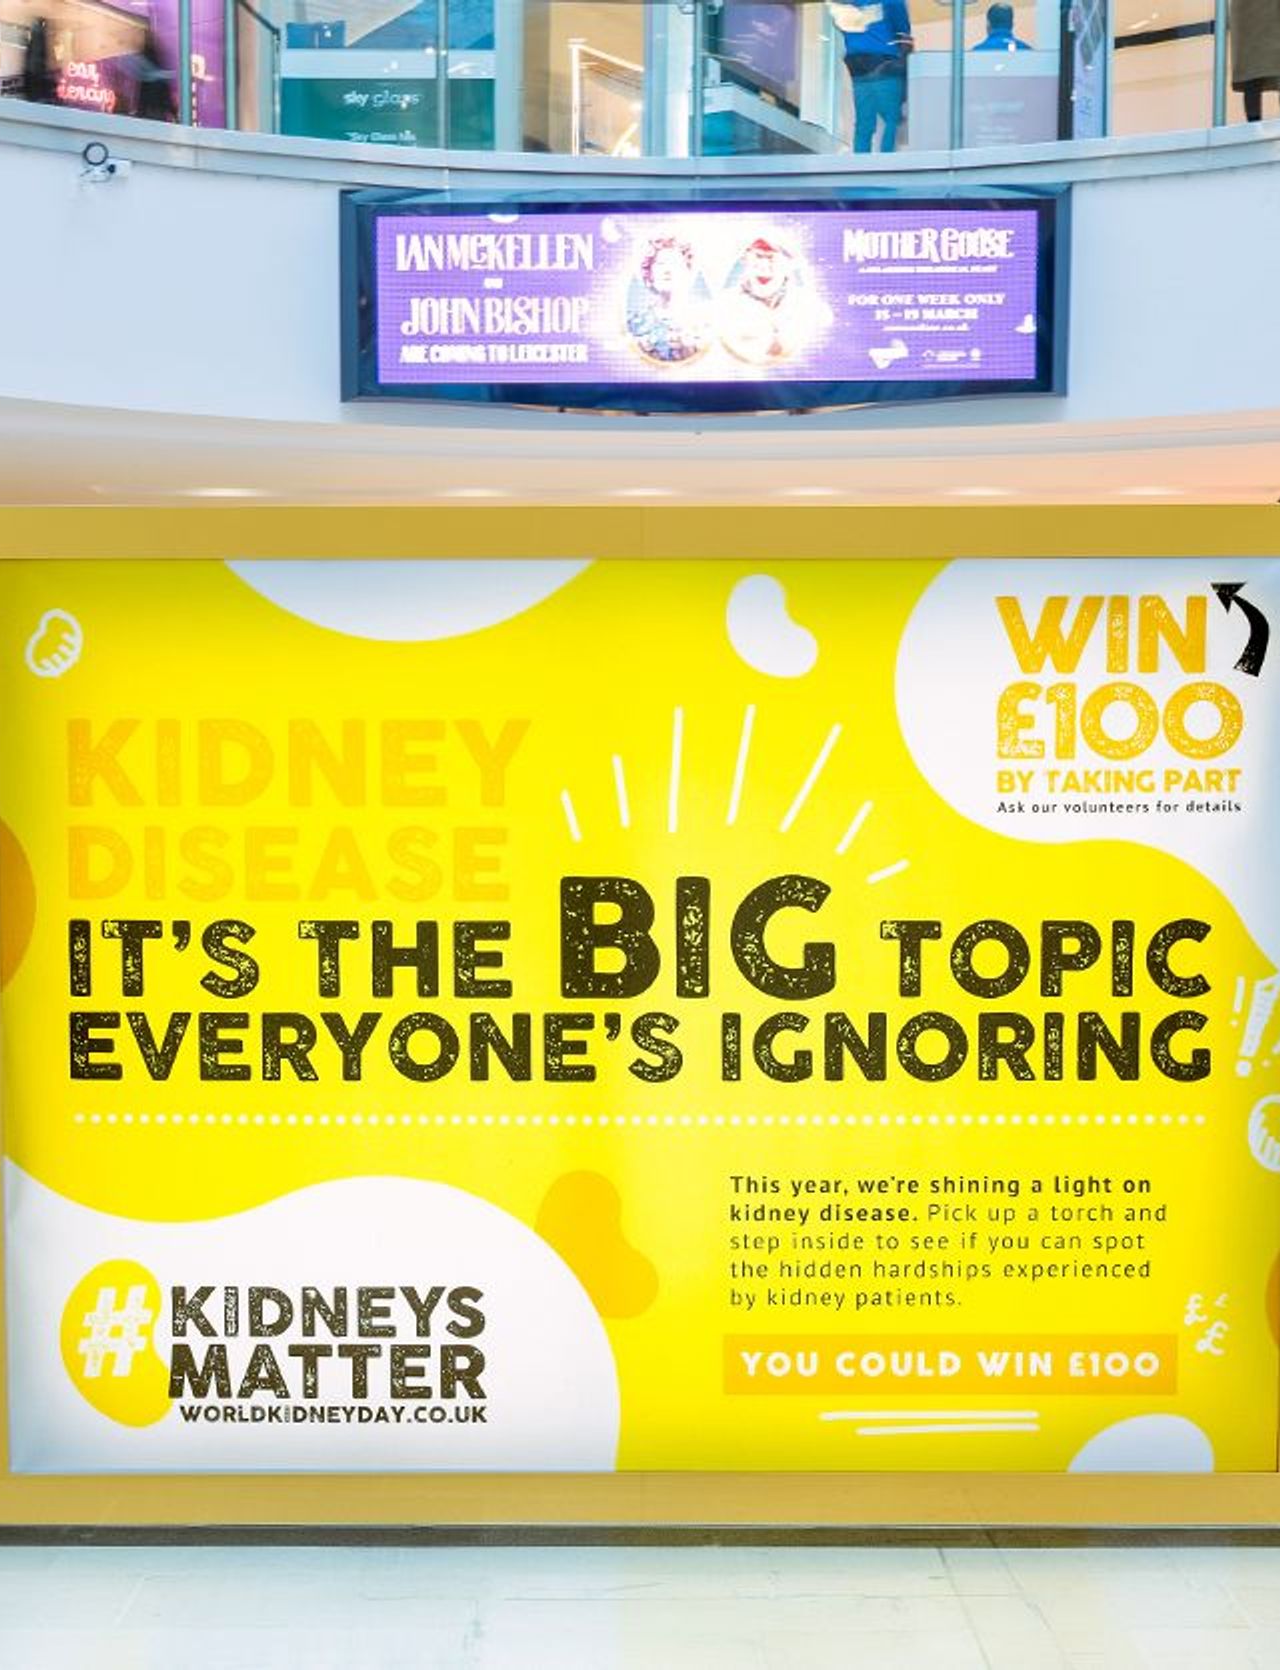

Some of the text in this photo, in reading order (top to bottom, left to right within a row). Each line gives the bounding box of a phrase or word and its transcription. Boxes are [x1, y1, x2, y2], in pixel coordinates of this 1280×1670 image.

[343, 90, 420, 109] sky glass
[396, 234, 444, 271] IAN
[843, 228, 1015, 263] MOTHER GOOSE
[848, 293, 1005, 305] FOR ONE WEEK ONLY
[401, 296, 590, 335] JOHN BISHOP
[922, 308, 978, 320] MARCH
[400, 345, 429, 364] ARE
[488, 345, 508, 363] TO
[510, 344, 589, 363] LEICESTER
[994, 595, 1208, 675] WIN
[997, 681, 1244, 761] £100
[66, 718, 532, 808] KIDNEY
[996, 769, 1242, 794] BY TAKING PART
[997, 800, 1242, 814] Ask our volunteers for details
[66, 825, 511, 902] DISEASE
[69, 875, 1211, 1000] IT'S THE BIG TOPIC
[69, 1011, 1211, 1082] EVERYONE'S IGNORING
[730, 1176, 1151, 1197] This year, we're shining a light on
[730, 1204, 1166, 1226] kidney disease. Pick up a torch and
[730, 1232, 1144, 1254] step inside to see if you can spot
[731, 1260, 1151, 1281] the hidden hardships experienced
[730, 1289, 962, 1310] by kidney patients.
[169, 1344, 486, 1398] MATTER
[741, 1351, 1160, 1377] YOU COULD WIN £100
[179, 1405, 487, 1424] WORLDKIDNEYDAY.CO.UK
